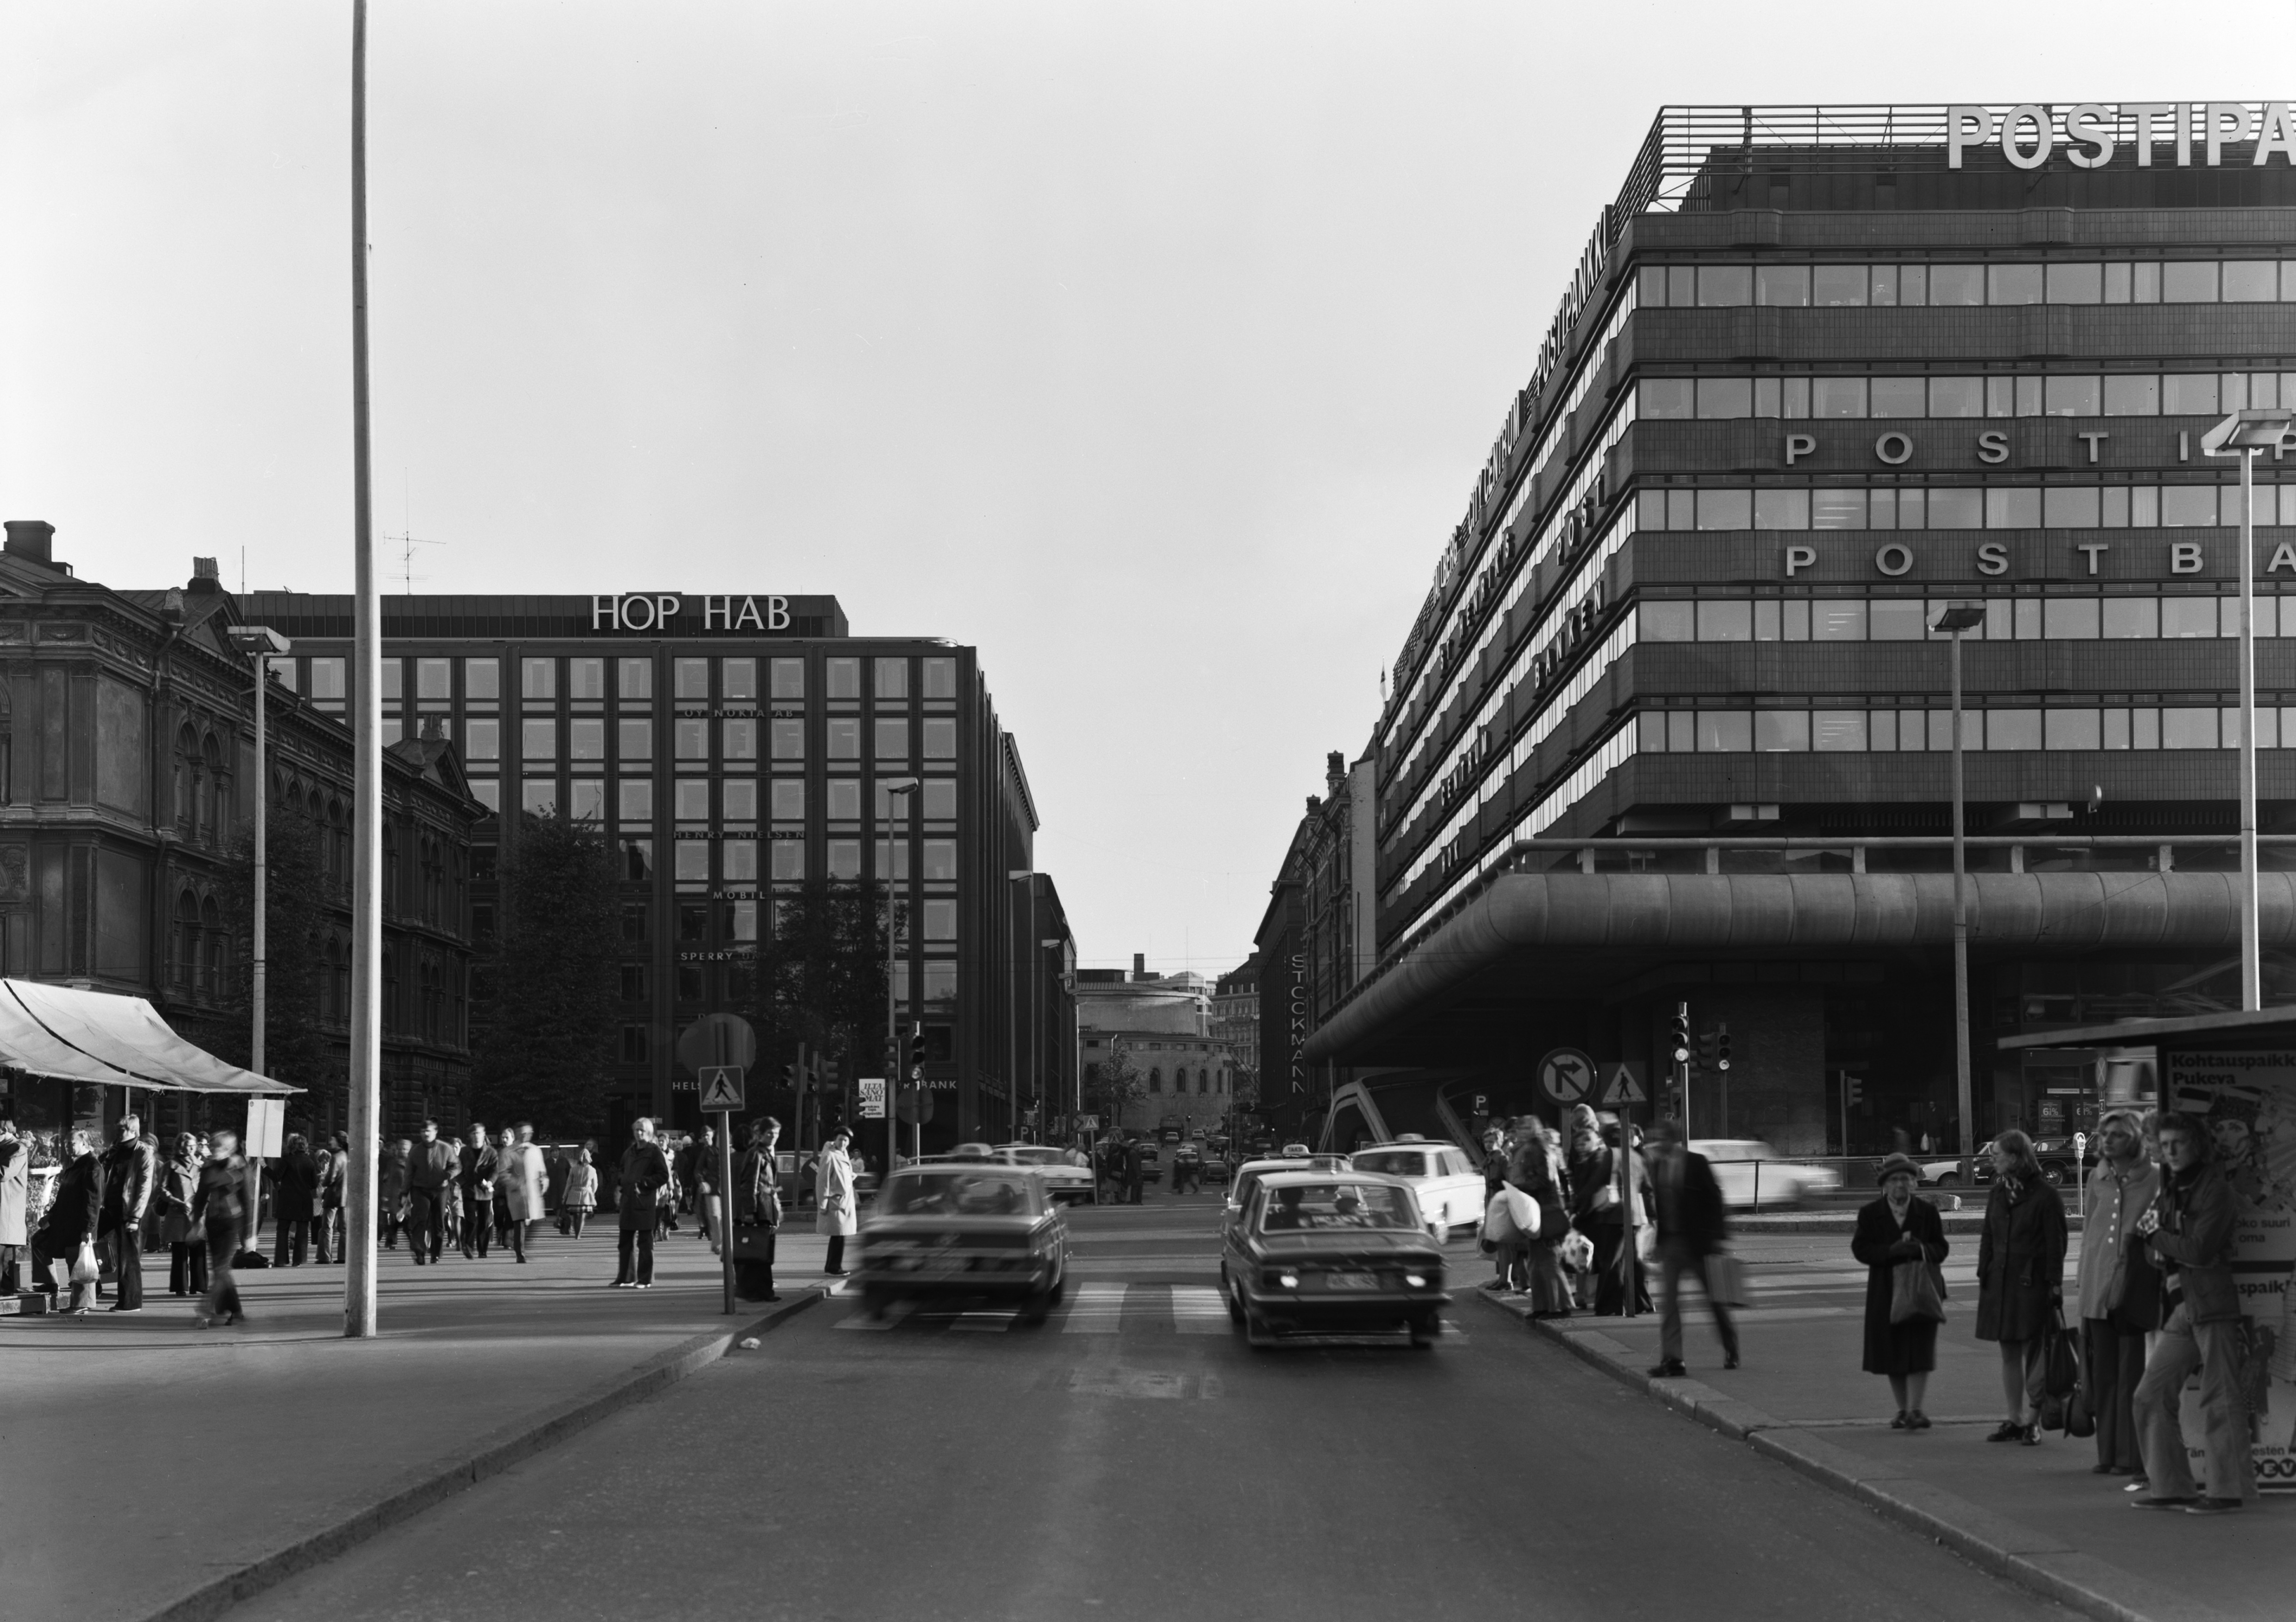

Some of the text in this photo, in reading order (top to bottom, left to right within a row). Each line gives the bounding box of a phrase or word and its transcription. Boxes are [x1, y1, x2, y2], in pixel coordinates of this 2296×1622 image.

[1947, 104, 2296, 169] POSTIPA
[1537, 205, 1612, 397] POSTIPANKKI
[1484, 390, 1524, 504] CENTRUM
[1557, 474, 1605, 566] POST
[1432, 526, 1461, 606] TALLBERG
[592, 595, 791, 630] HOP HAB
[1535, 581, 1605, 690] BANKEN
[1440, 639, 1454, 671] ST
[684, 709, 793, 718] OY NOKIA AB
[1441, 730, 1492, 807] CENTRUM
[713, 891, 765, 900] MOBIL
[680, 952, 733, 961] SPERRY
[2172, 1053, 2296, 1071] Kohtauspaikk
[2172, 1071, 2236, 1085] Pukeva
[1475, 1095, 1487, 1108] P
[1020, 1126, 1029, 1141] P
[2261, 1217, 2290, 1228] suuri
[2238, 1234, 2265, 1243] oma
